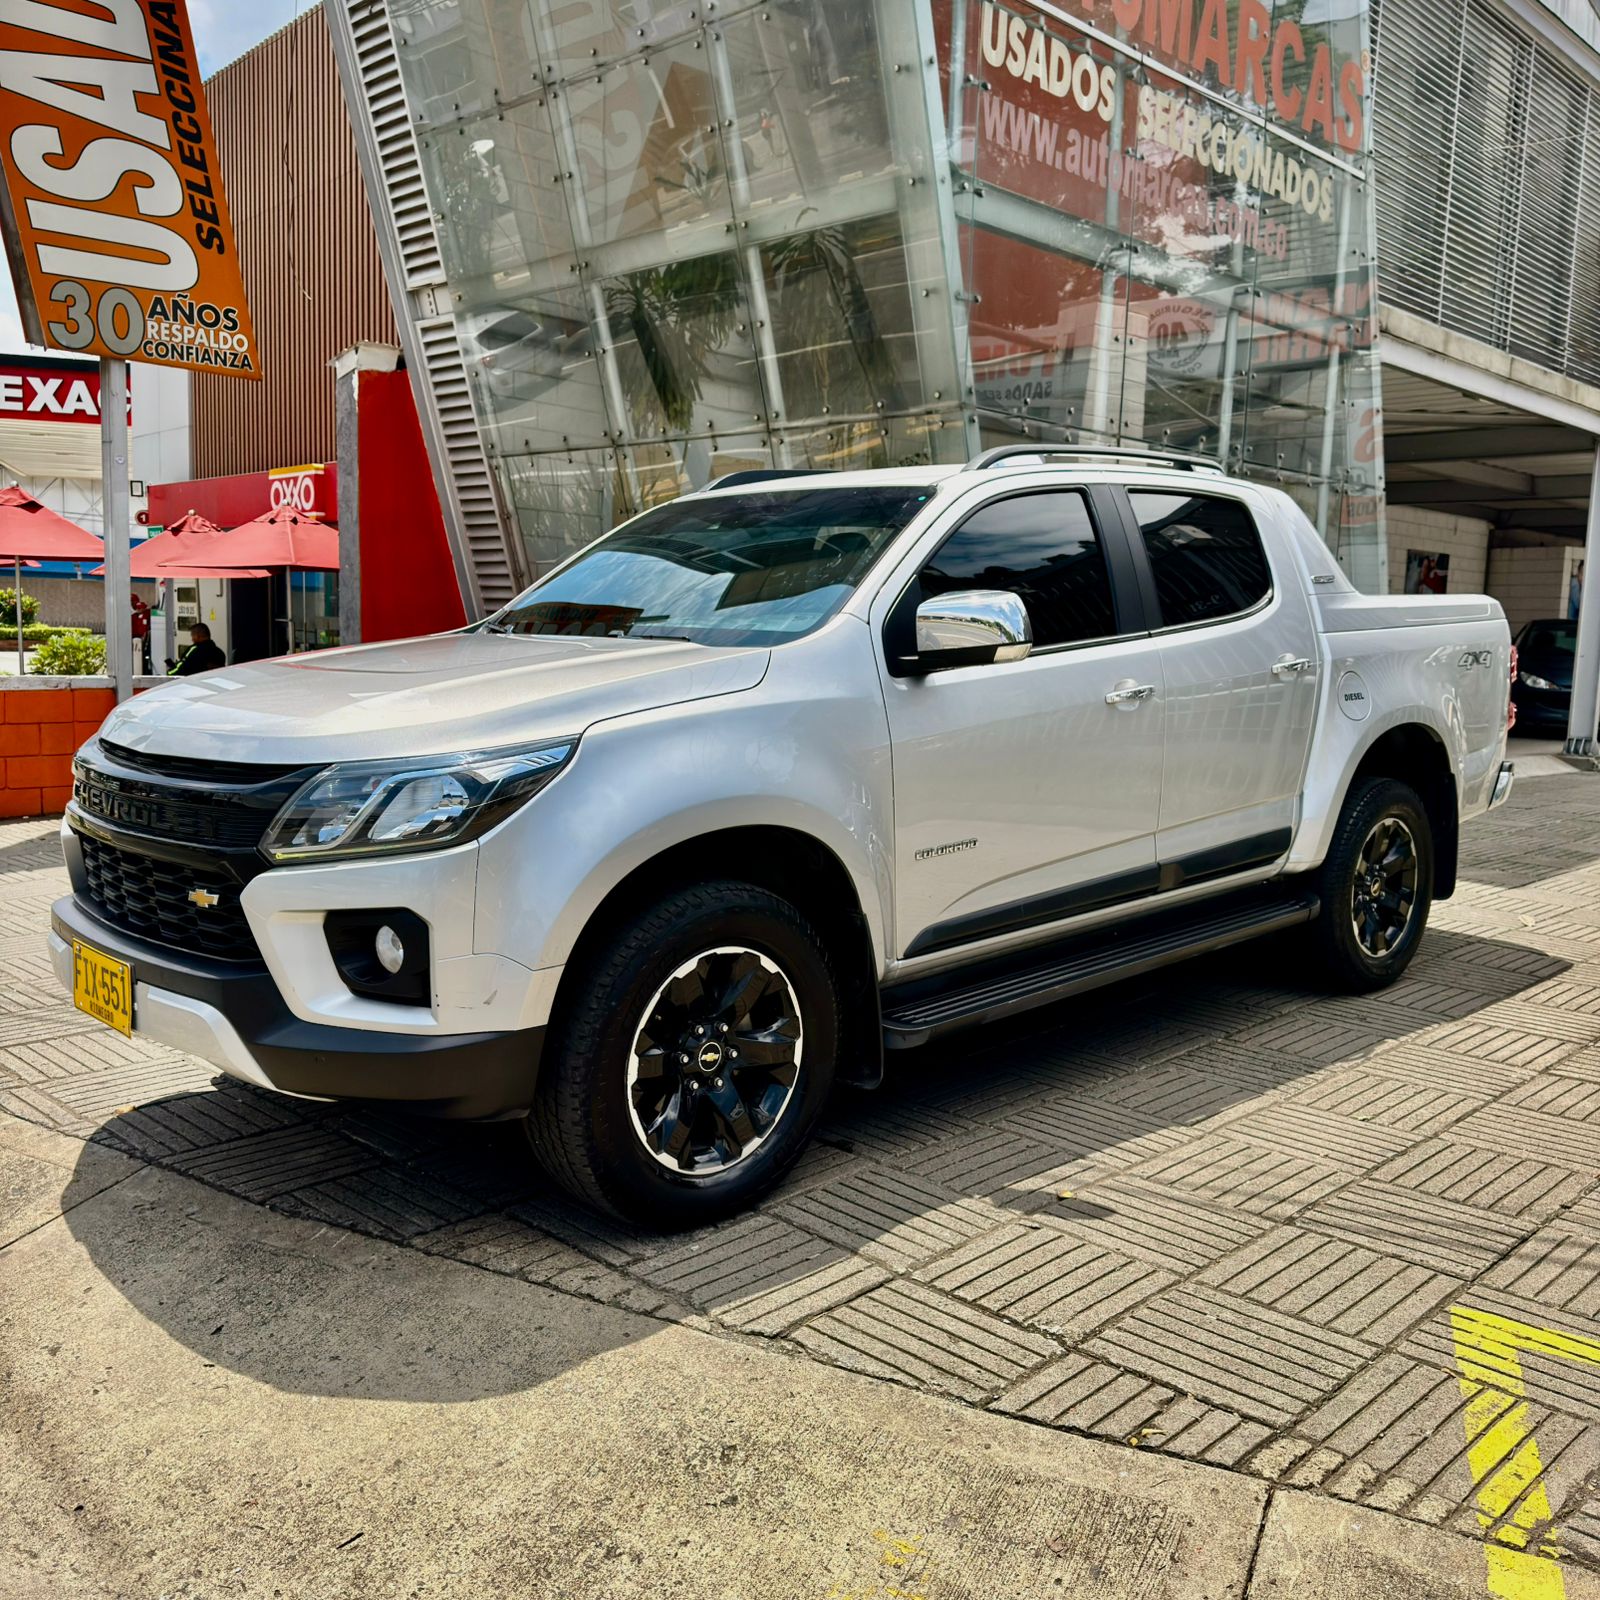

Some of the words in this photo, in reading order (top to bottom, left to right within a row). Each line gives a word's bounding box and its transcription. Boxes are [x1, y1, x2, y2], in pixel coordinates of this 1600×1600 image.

[981, 1, 1117, 122] USADOS
[1137, 84, 1334, 223] SELECCIONADOS
[48, 279, 145, 355] 30
[146, 292, 239, 332] AÑOS
[146, 320, 249, 353] RESPALDO
[141, 340, 254, 372] CONFIANZA
[270, 474, 315, 511] OXXO
[1344, 692, 1364, 701] DIESEL
[915, 837, 978, 861] COLORADO
